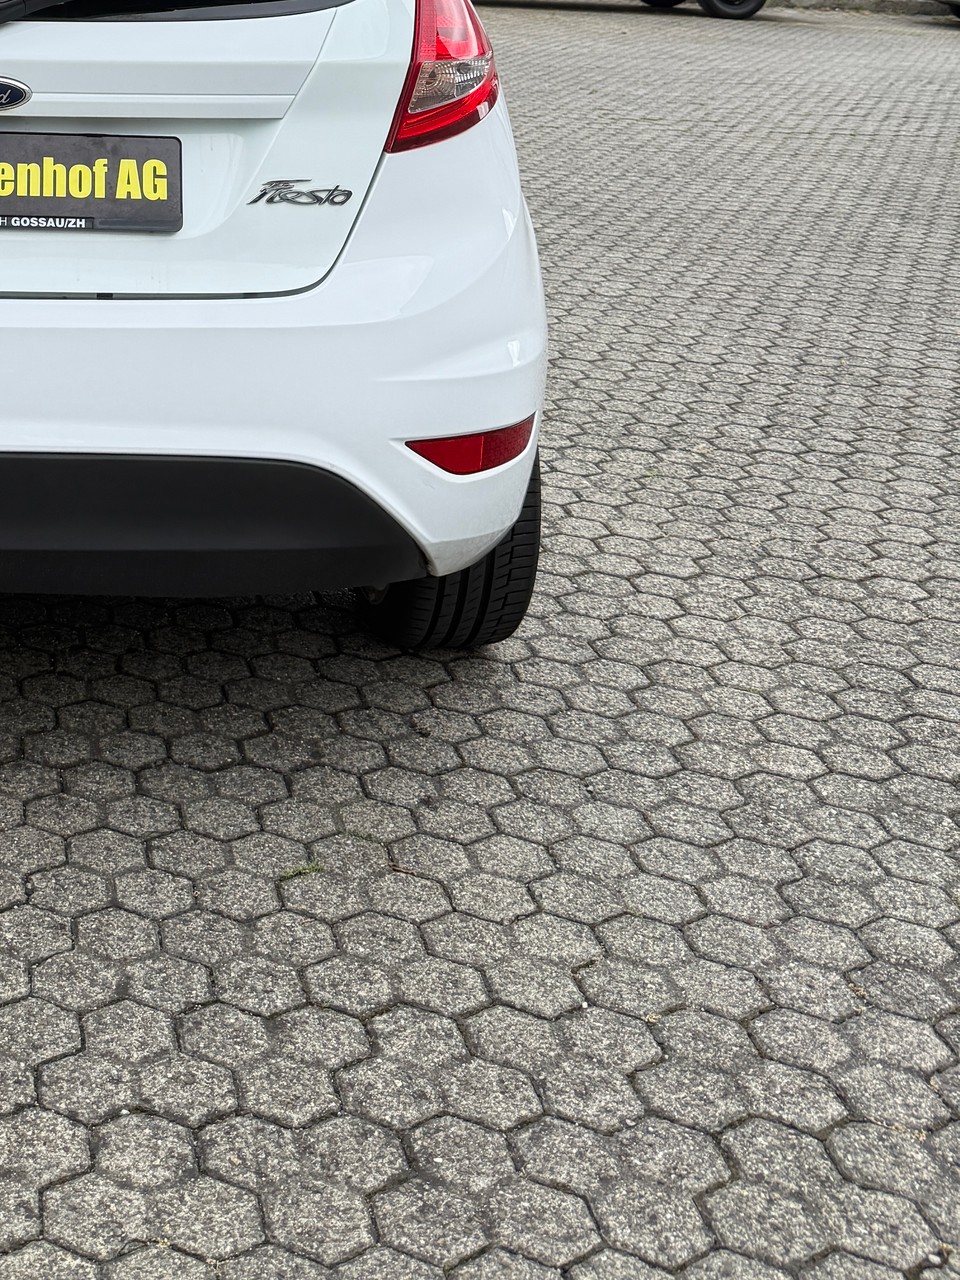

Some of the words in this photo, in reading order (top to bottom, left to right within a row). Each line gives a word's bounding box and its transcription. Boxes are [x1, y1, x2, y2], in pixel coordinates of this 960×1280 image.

[115, 158, 168, 201] AG
[246, 179, 353, 206] Fiesta
[11, 217, 86, 230] GOSSAU/ZH
